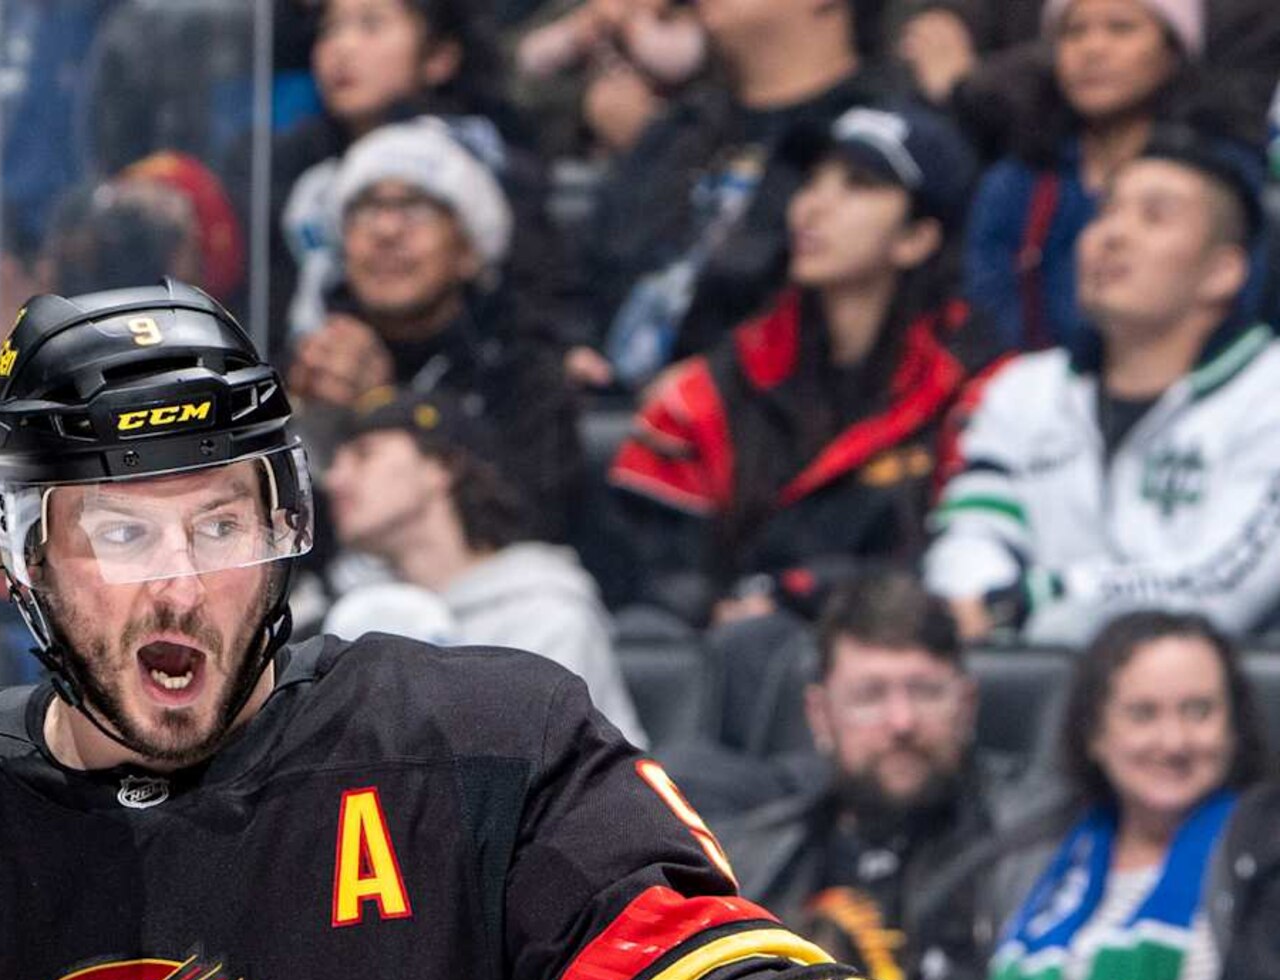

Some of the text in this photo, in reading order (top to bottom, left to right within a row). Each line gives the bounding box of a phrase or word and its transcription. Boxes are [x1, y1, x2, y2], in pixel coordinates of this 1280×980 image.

[128, 317, 163, 346] 9
[117, 401, 211, 431] CCM
[331, 786, 413, 928] A
